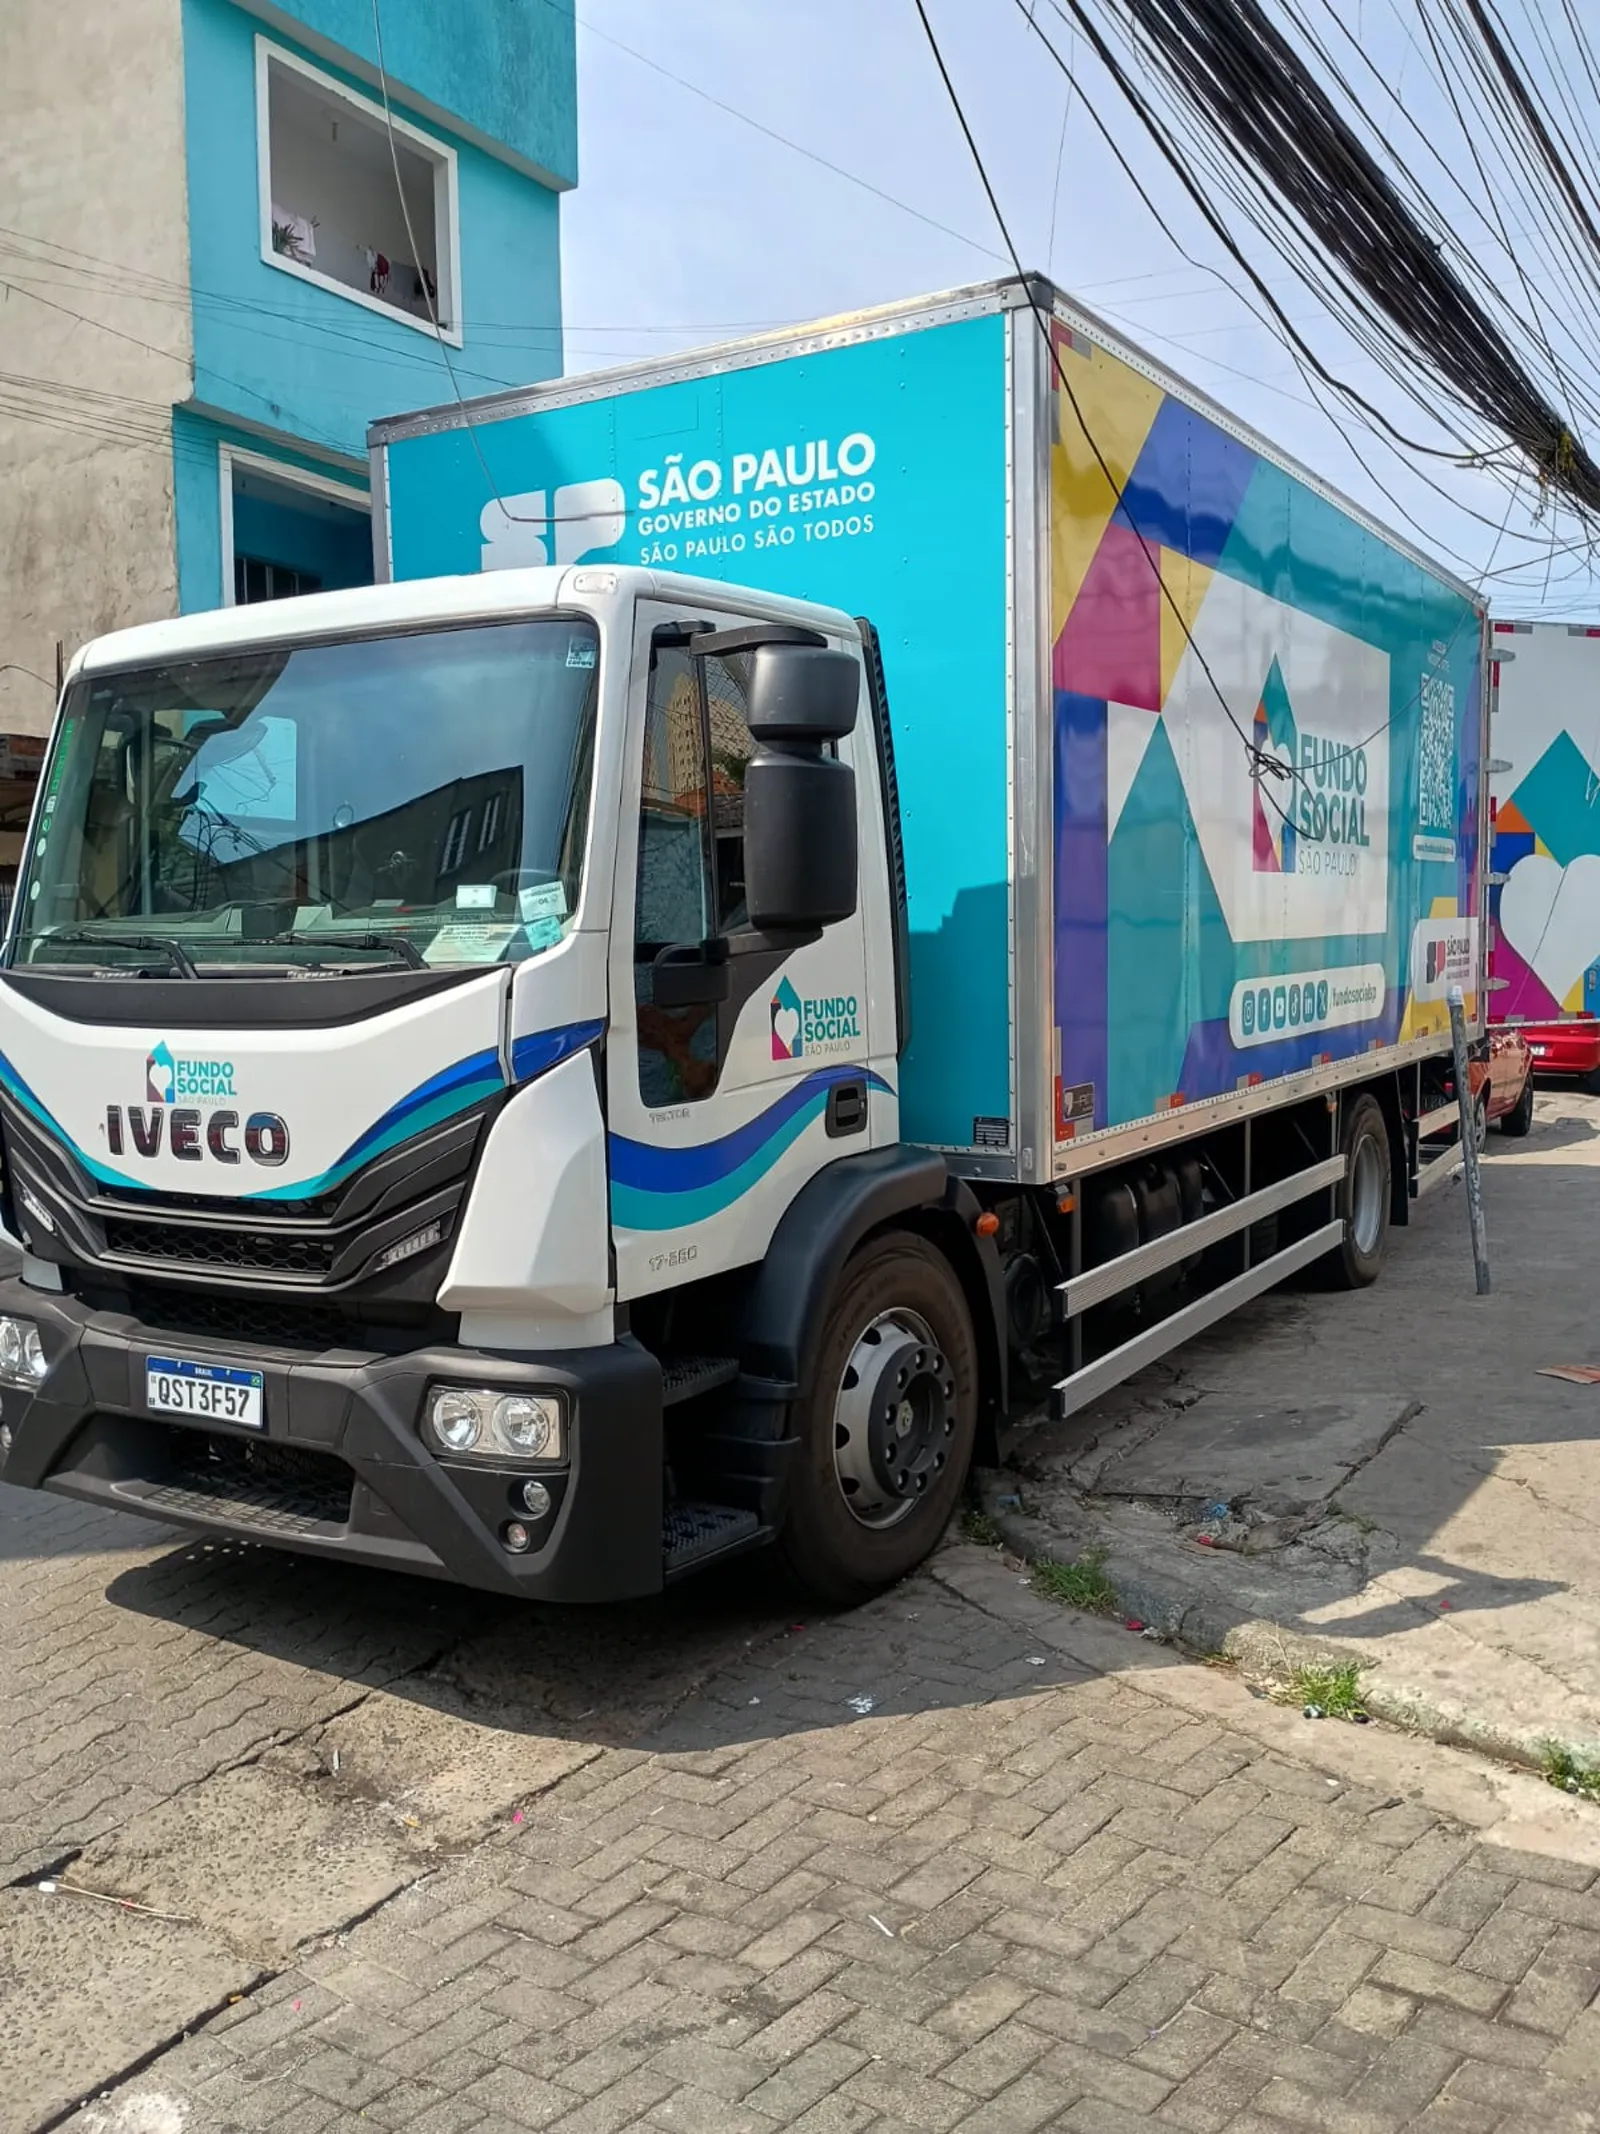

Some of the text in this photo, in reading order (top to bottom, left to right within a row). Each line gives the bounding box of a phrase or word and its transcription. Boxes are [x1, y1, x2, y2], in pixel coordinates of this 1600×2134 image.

[638, 432, 876, 510] SÃO PAULO
[638, 481, 876, 536] GOVERNO DO ESTADO
[640, 514, 875, 566] SÃO PAULO SÃO TODOS
[1300, 733, 1368, 797] FUNDO
[1300, 788, 1370, 847] SOCIAL
[1299, 845, 1357, 876] SÃO PAULO
[803, 996, 857, 1020] FUNDO
[804, 1017, 861, 1042] SOCIAL
[805, 1041, 850, 1056] SÃO PAULO
[177, 1060, 234, 1079] FUNDO
[177, 1077, 238, 1096] SOCIAL
[107, 1104, 291, 1167] IVECO
[158, 1376, 251, 1418] QST3F57
